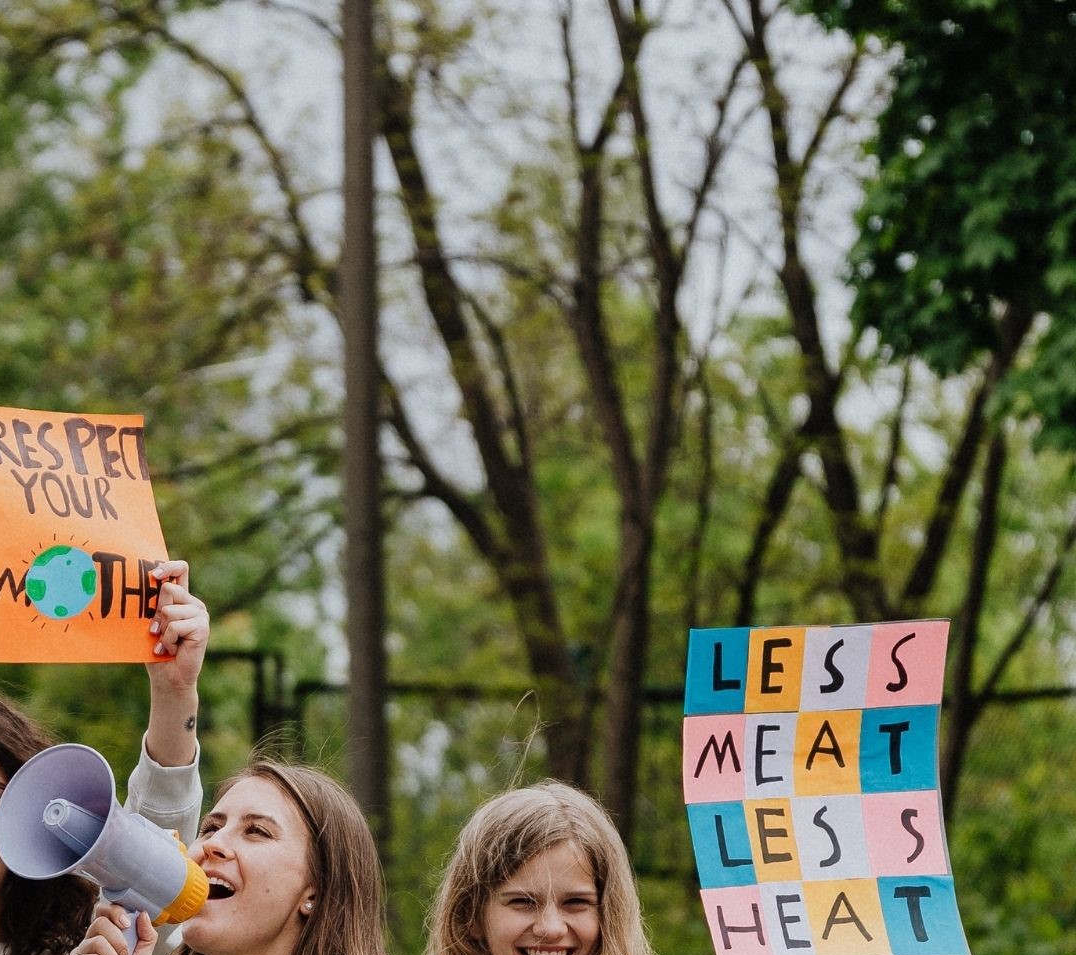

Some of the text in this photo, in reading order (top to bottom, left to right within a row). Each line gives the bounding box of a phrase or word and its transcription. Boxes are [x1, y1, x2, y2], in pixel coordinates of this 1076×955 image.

[10, 468, 118, 521] YOUR
[712, 632, 916, 694] LESS
[694, 719, 910, 787] MEAT
[714, 805, 925, 869] LESS
[716, 885, 932, 951] HEAT
